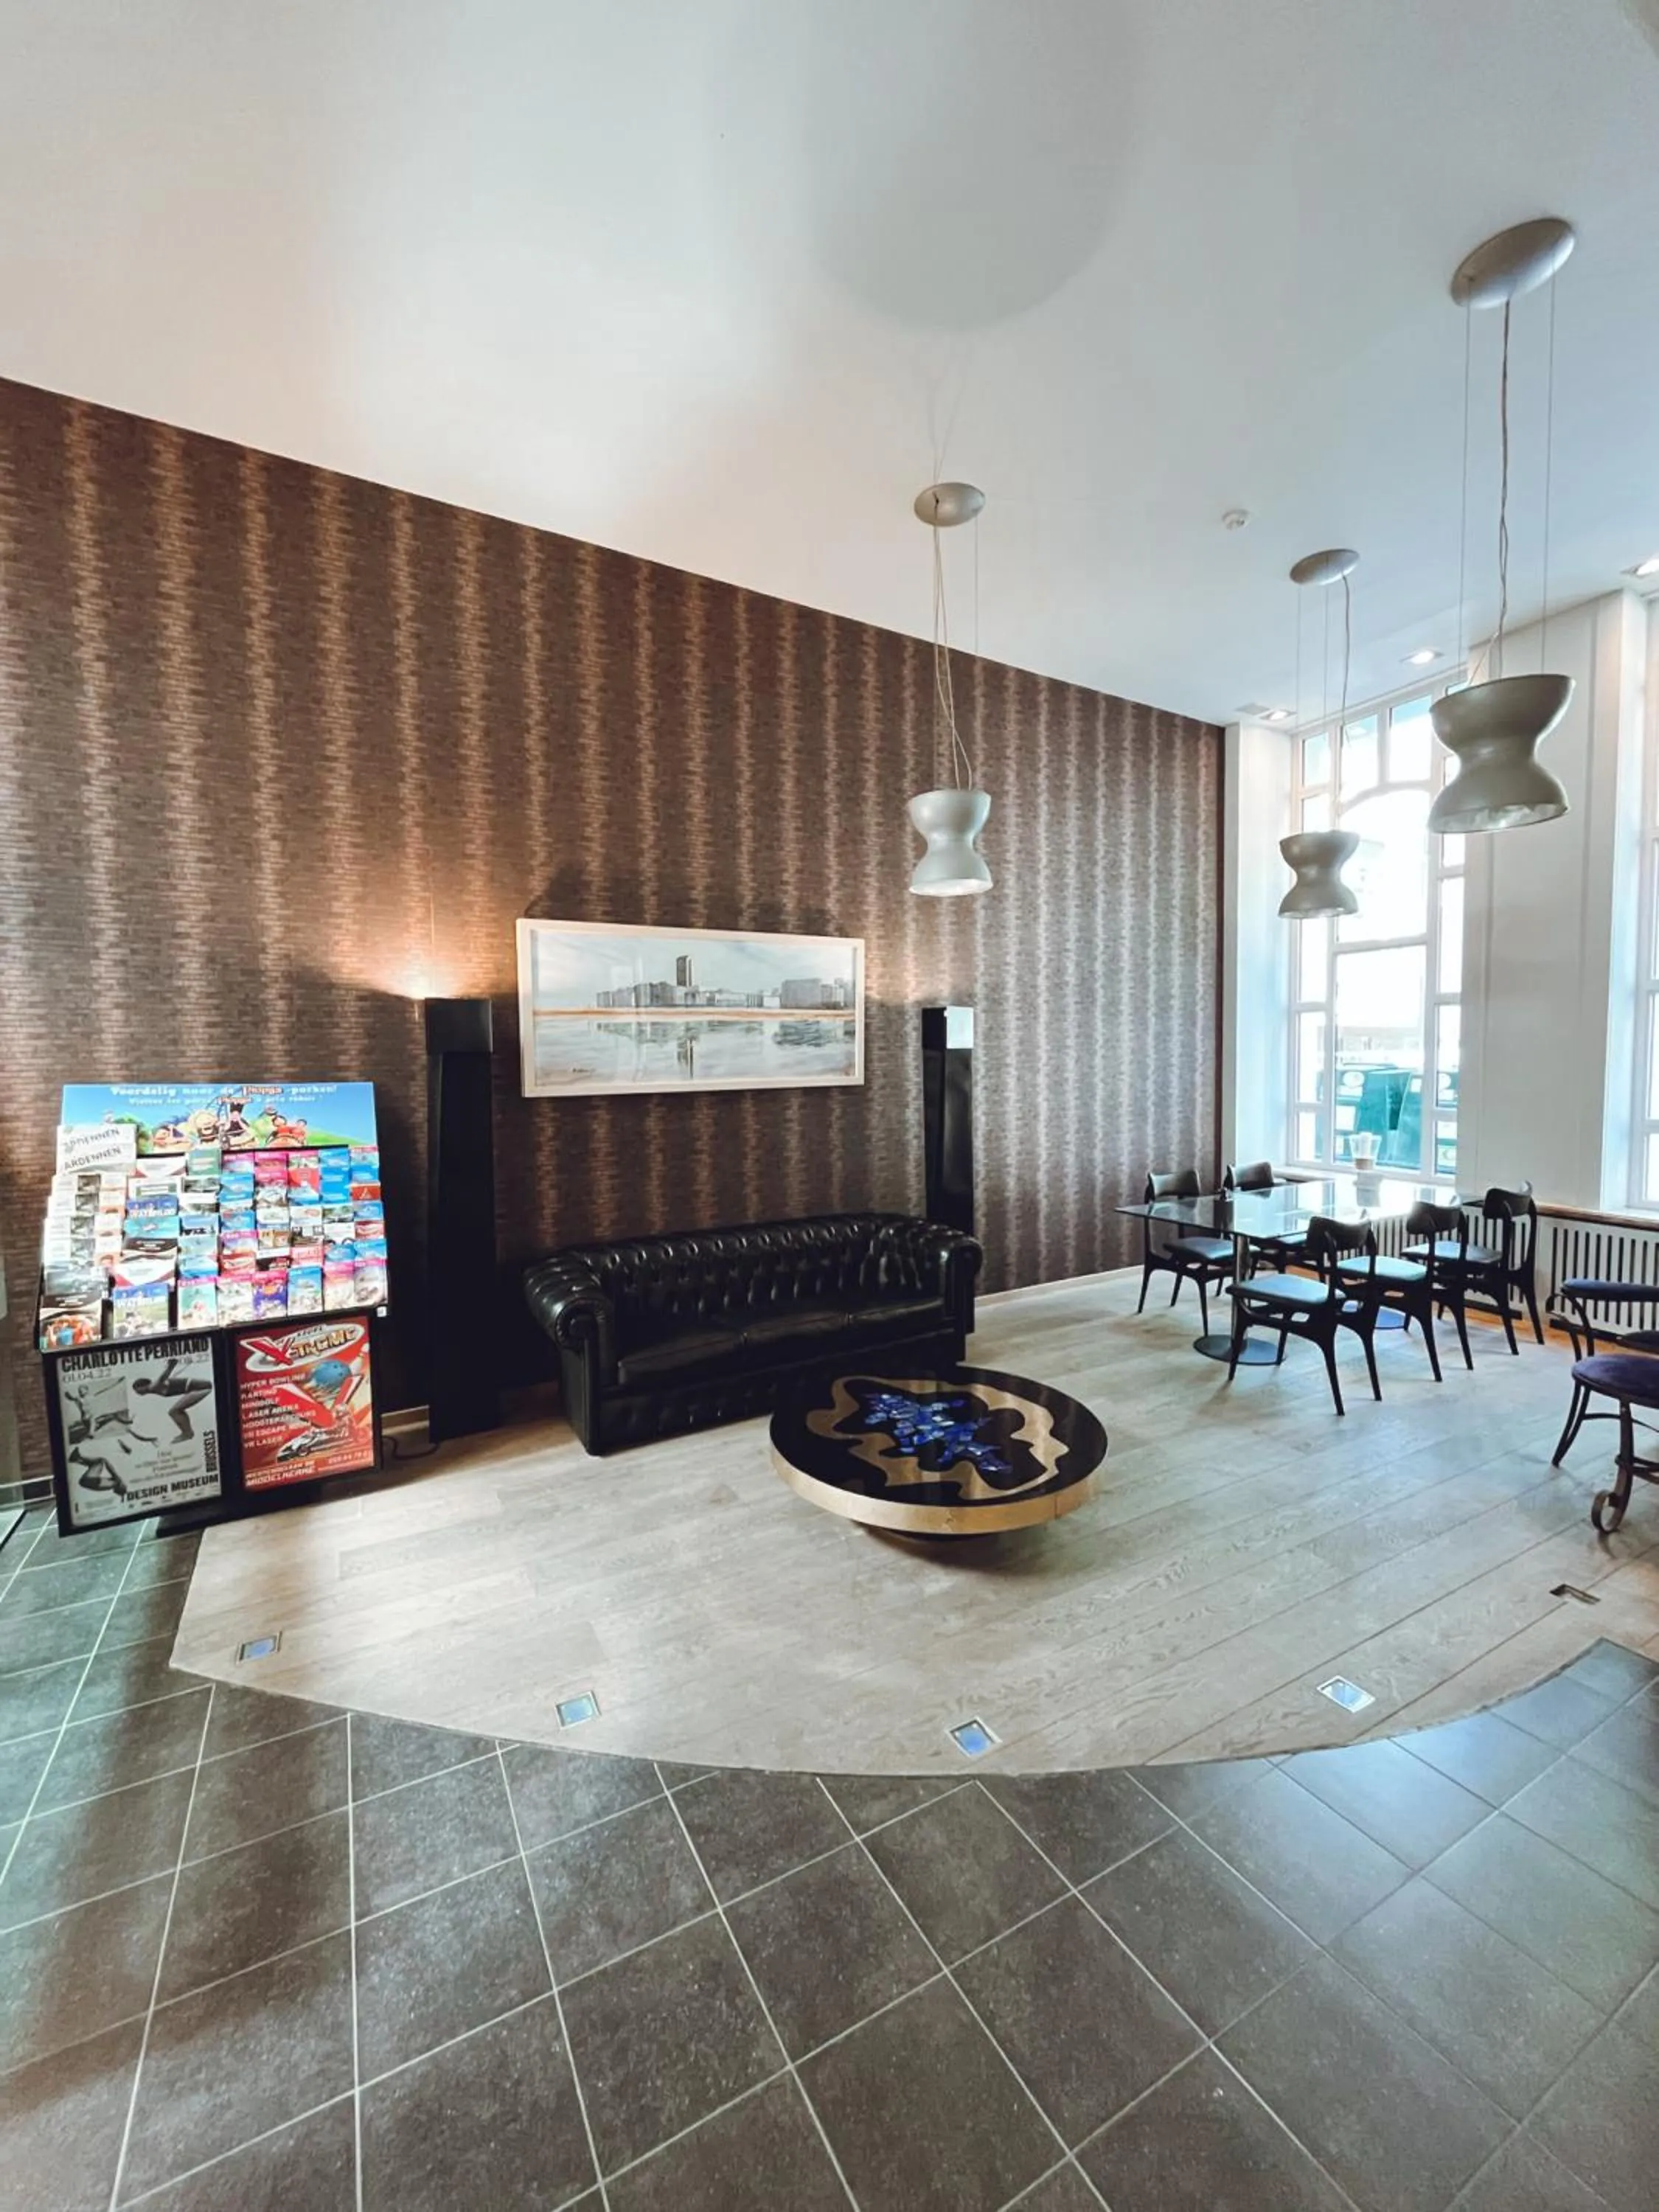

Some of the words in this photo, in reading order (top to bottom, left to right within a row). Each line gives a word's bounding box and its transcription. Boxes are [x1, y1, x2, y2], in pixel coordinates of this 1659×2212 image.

[64, 1147, 122, 1170] ARDENNEN
[61, 1346, 144, 1372] CHARLOTTE
[146, 1338, 210, 1361] PERRIAND
[127, 1484, 168, 1501] DESIGN
[171, 1473, 219, 1492] MUSEUM
